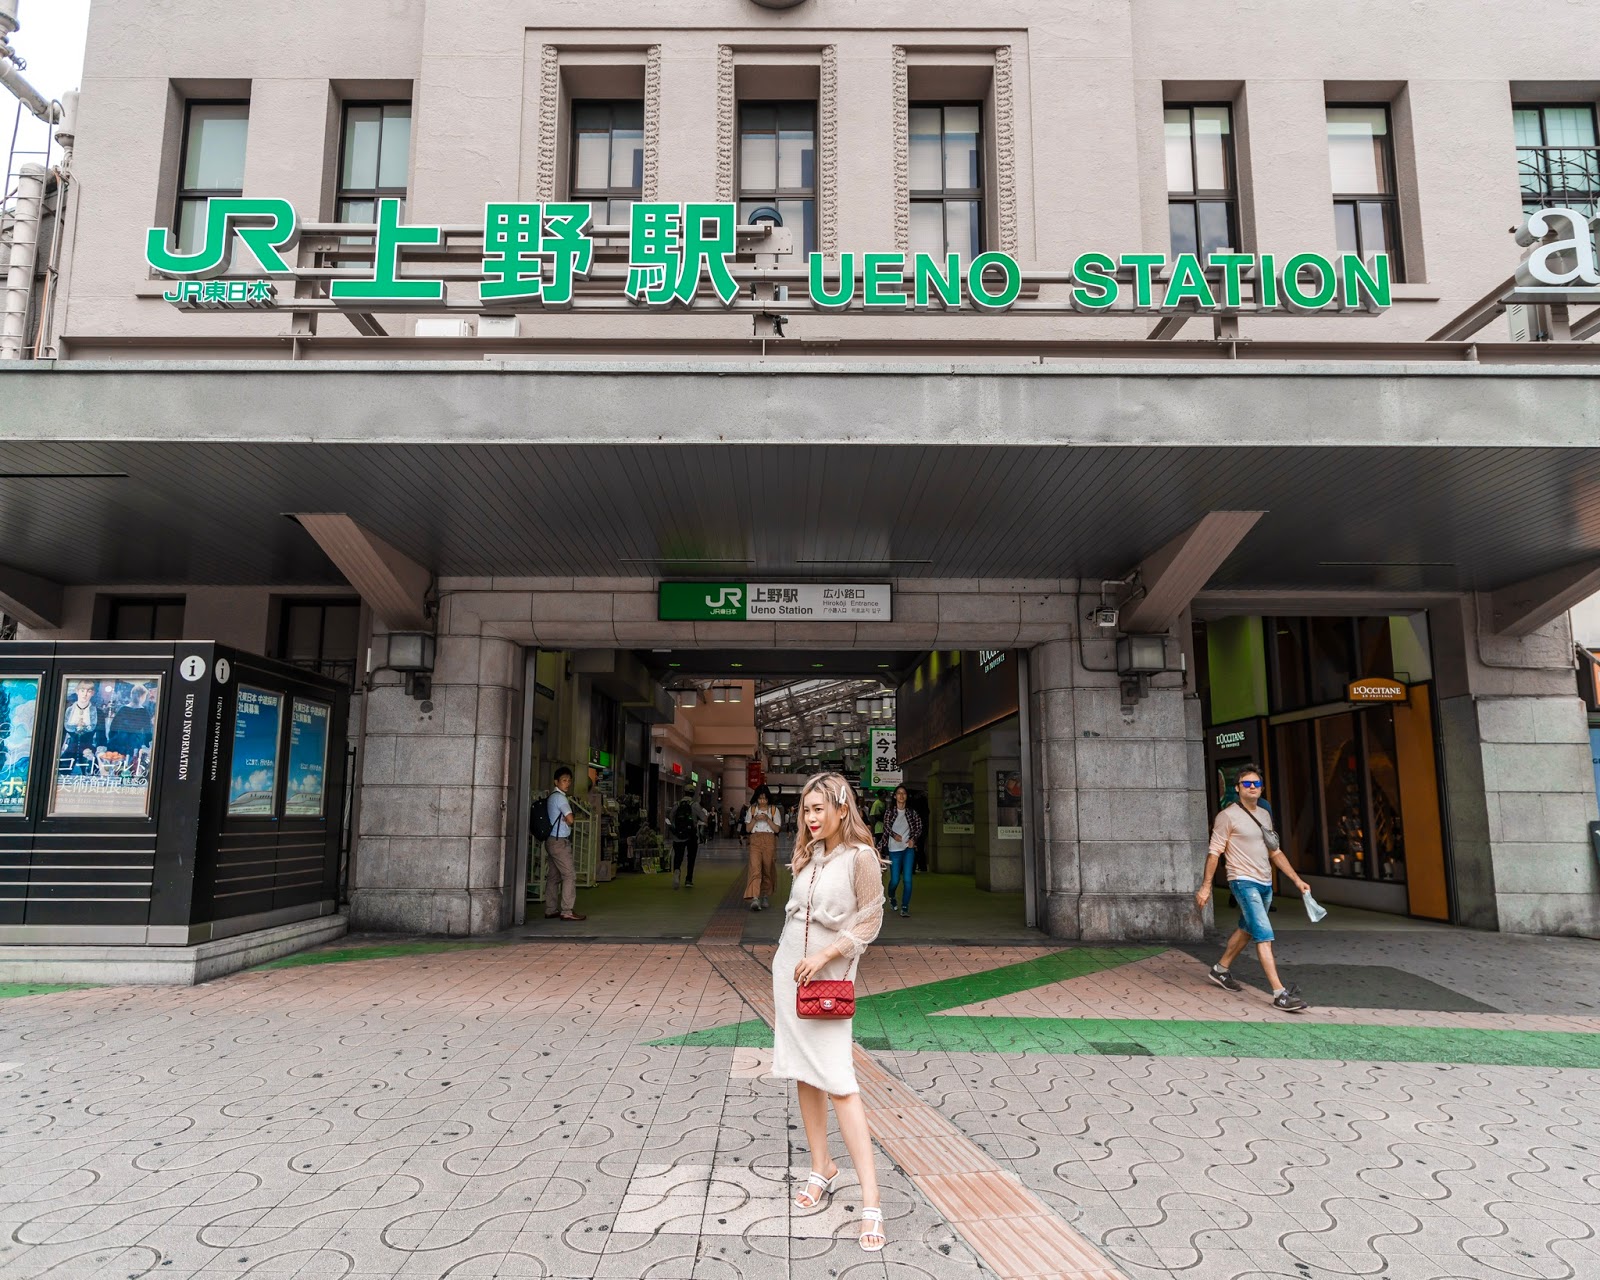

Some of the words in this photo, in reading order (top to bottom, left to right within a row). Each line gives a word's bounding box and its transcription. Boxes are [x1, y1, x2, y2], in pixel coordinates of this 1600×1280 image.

[145, 197, 297, 275] JR
[330, 198, 740, 306] 上野駅
[808, 251, 1022, 308] UENO
[1071, 252, 1393, 309] STATION
[163, 280, 272, 303] JR東日本
[705, 587, 742, 608] JR
[751, 588, 798, 603] 上野駅
[823, 588, 865, 599] 広小路口
[751, 605, 776, 615] Ueno
[779, 605, 813, 615] Station
[1353, 685, 1402, 695] L'OCCITANE
[185, 693, 195, 718] UENO
[178, 720, 192, 781] INFORMATION
[211, 722, 220, 781] INFORMATION
[57, 756, 150, 777] コートールド
[57, 774, 121, 794] 美術館展
